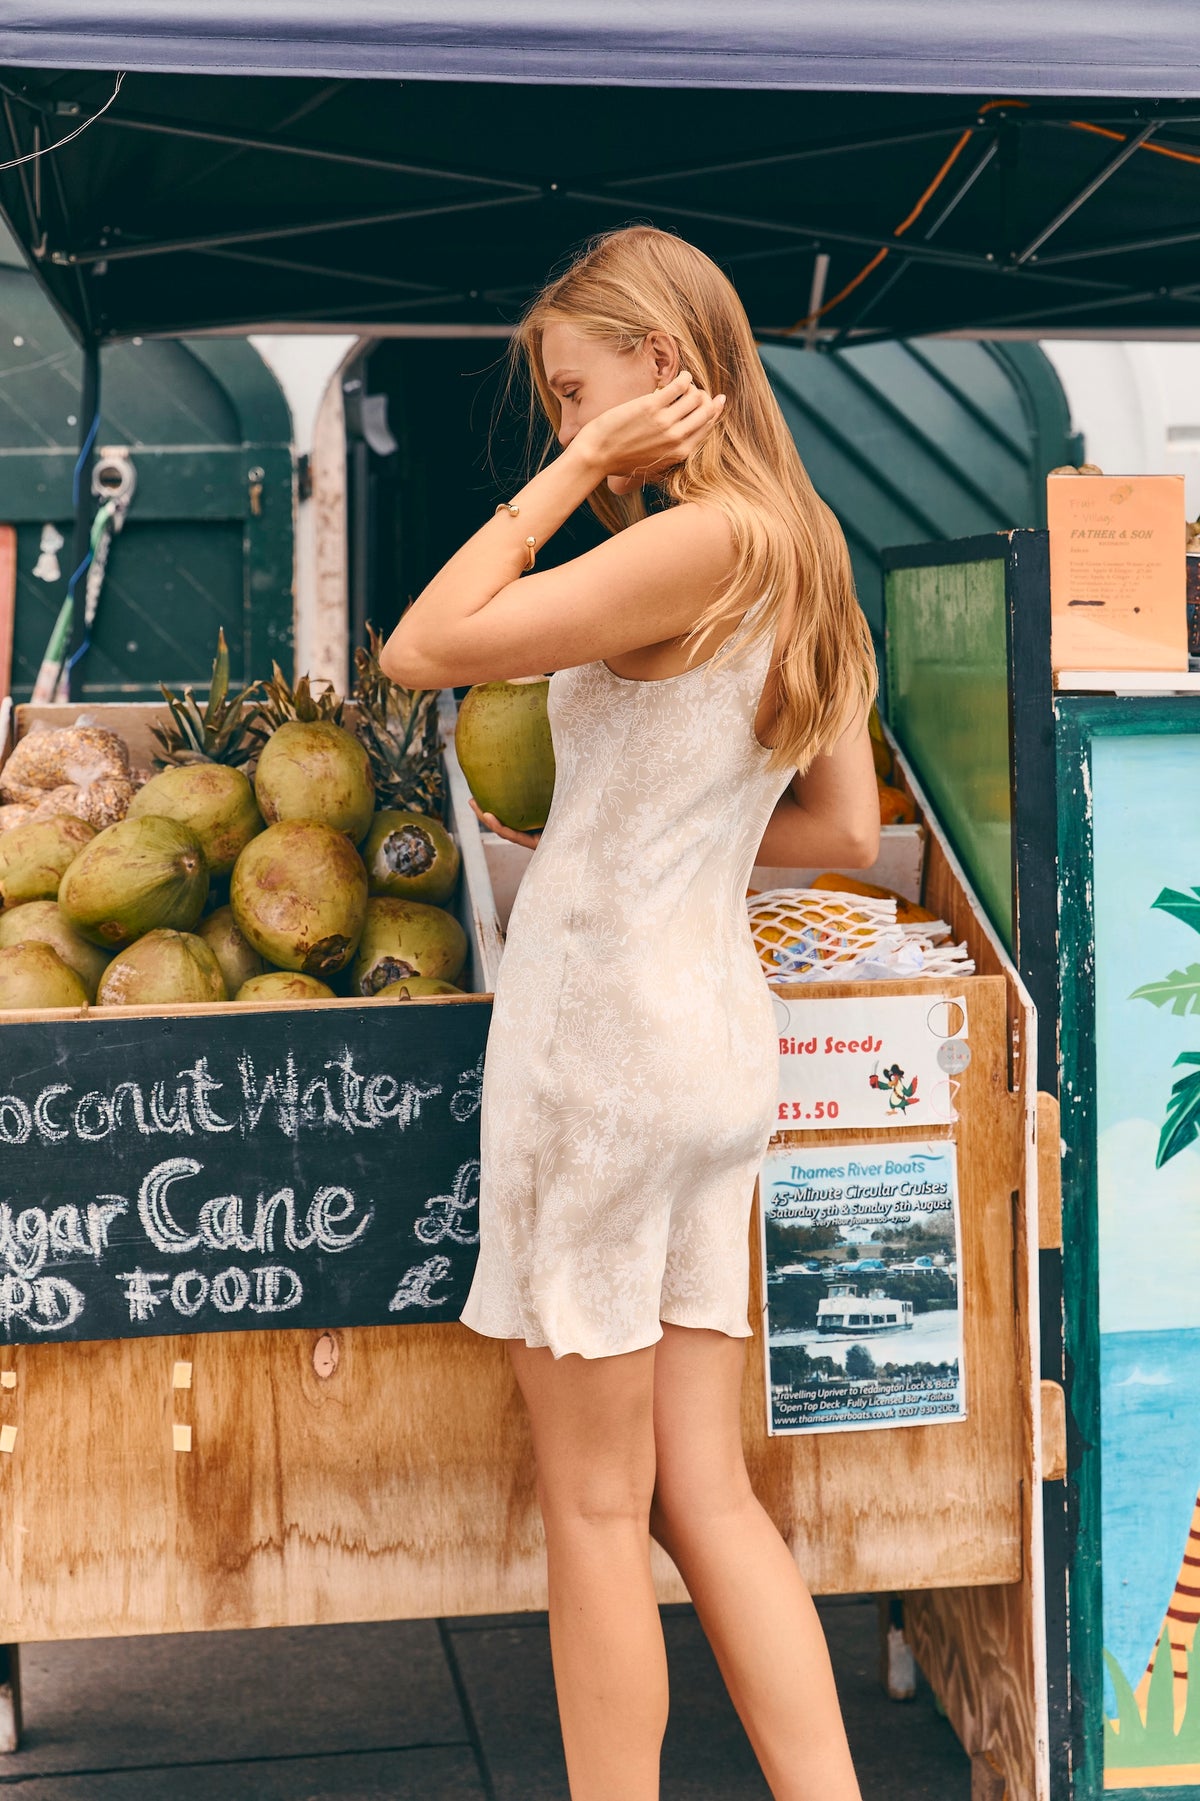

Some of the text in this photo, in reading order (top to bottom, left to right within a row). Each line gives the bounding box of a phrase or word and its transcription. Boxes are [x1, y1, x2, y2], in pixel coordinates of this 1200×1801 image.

[1070, 529, 1154, 539] FATHER & SON
[778, 1035, 883, 1055] Bird Seeds
[238, 1043, 442, 1140] Water
[778, 1101, 839, 1120] £3.50
[790, 1160, 925, 1180] Thames River Boats
[771, 1181, 948, 1207] 45-Minute Circular Cruises
[138, 1156, 375, 1254] Cane
[769, 1198, 952, 1220] Saturday 5th & Sunday 6th August
[810, 1218, 833, 1229] Every
[832, 1217, 851, 1226] Hour
[115, 1266, 304, 1322] FOOD
[775, 1379, 957, 1402] Travelling Upriver to Teddington Lock & Back
[779, 1403, 803, 1414] Open
[802, 1401, 819, 1413] Top
[819, 1399, 841, 1411] Deck
[847, 1398, 868, 1410] Fully
[868, 1395, 904, 1408] Licensed
[905, 1393, 921, 1403] Bar
[774, 1409, 895, 1426] www.thamesriverboats.co.uk
[920, 1405, 936, 1416] 930
